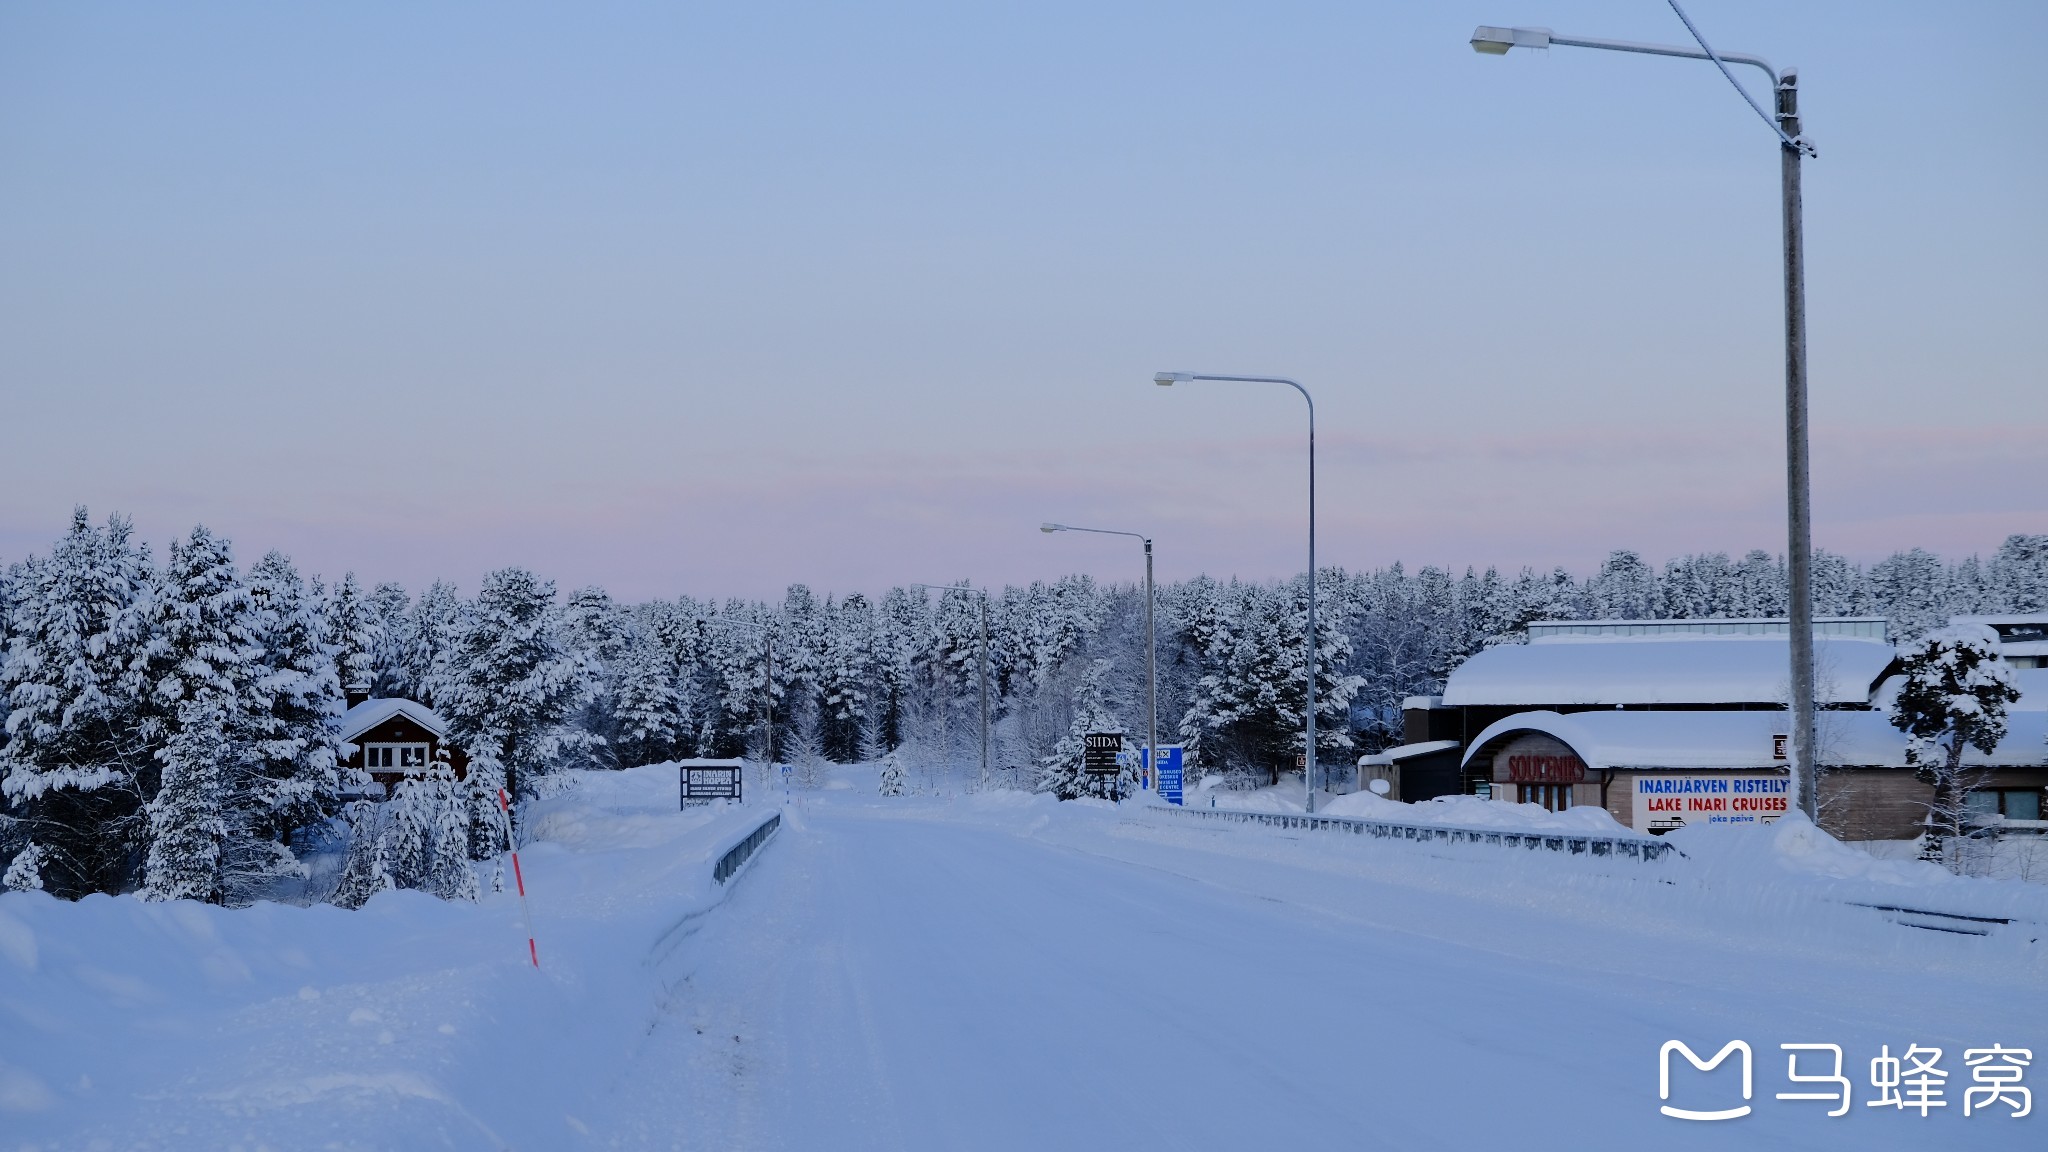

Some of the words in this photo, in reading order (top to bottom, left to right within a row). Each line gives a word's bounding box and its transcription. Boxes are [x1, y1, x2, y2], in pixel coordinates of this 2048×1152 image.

[1086, 737, 1118, 747] SIIDA
[1508, 755, 1585, 782] SOUVENIRS
[1639, 777, 1727, 793] INARIJÄRVEN
[1648, 798, 1682, 811] LAKE
[1688, 798, 1726, 811] INARI
[1732, 797, 1787, 811] CRUISES
[1709, 814, 1727, 824] joka
